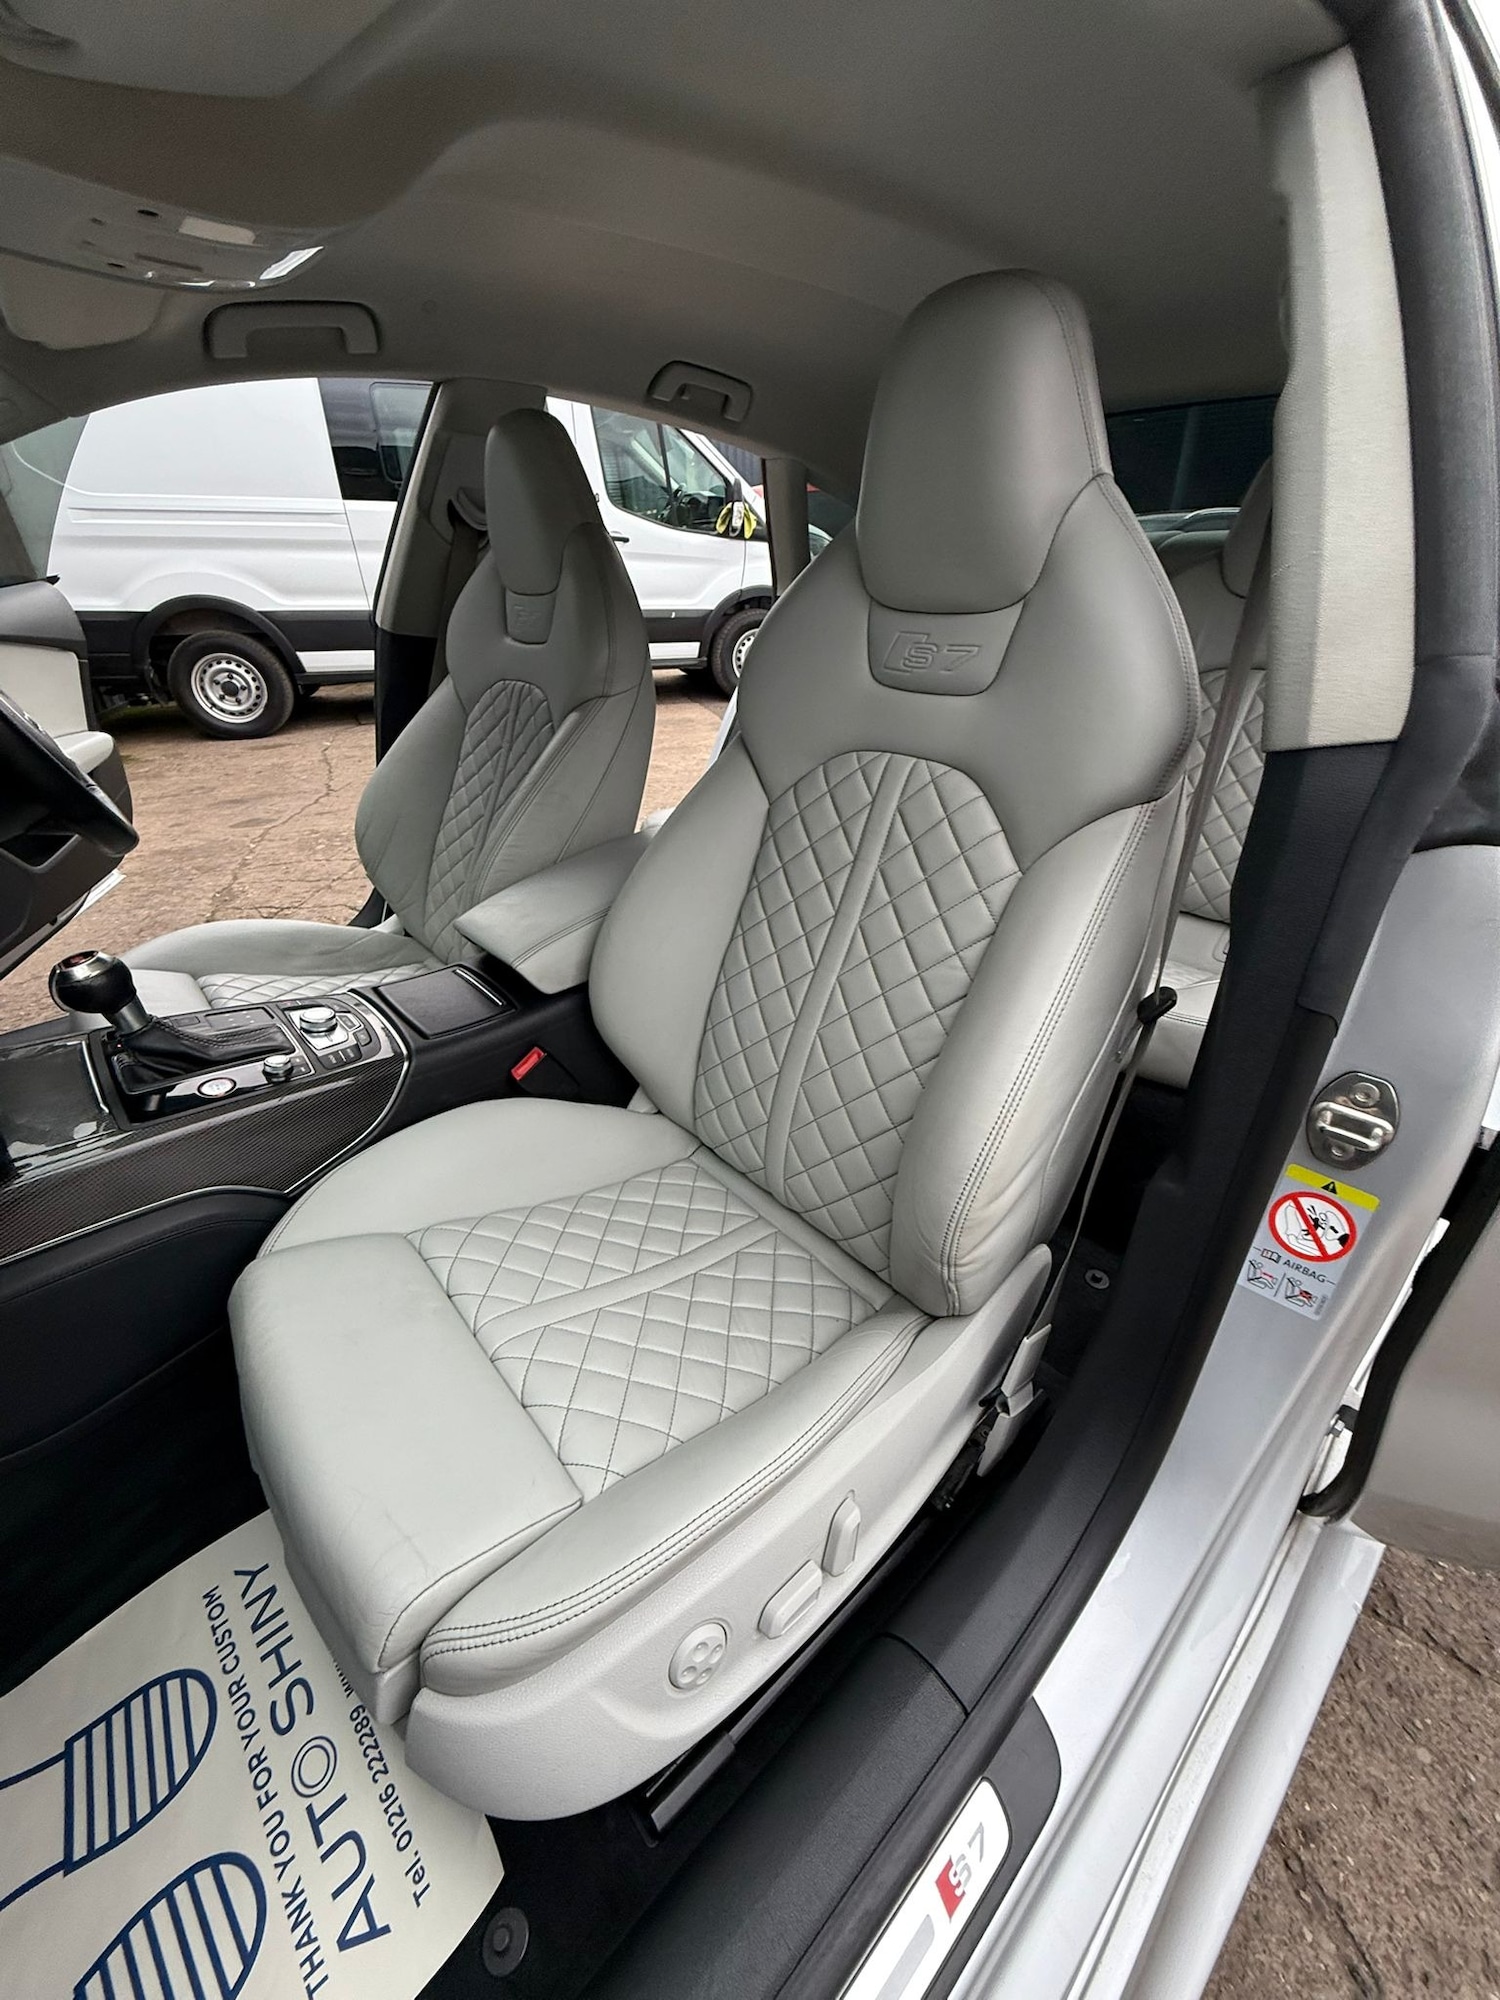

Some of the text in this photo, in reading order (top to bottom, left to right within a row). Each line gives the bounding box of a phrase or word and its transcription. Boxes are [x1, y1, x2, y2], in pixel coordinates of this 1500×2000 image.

[901, 641, 982, 675] S7
[1282, 1260, 1327, 1284] AIRBAG
[202, 1585, 329, 2000] THANK YOU FOR YOUR CUSTOM
[233, 1563, 391, 1953] AUTO SHINY
[349, 1704, 430, 1908] Tel. 01216 222289
[947, 1821, 985, 1899] S7
